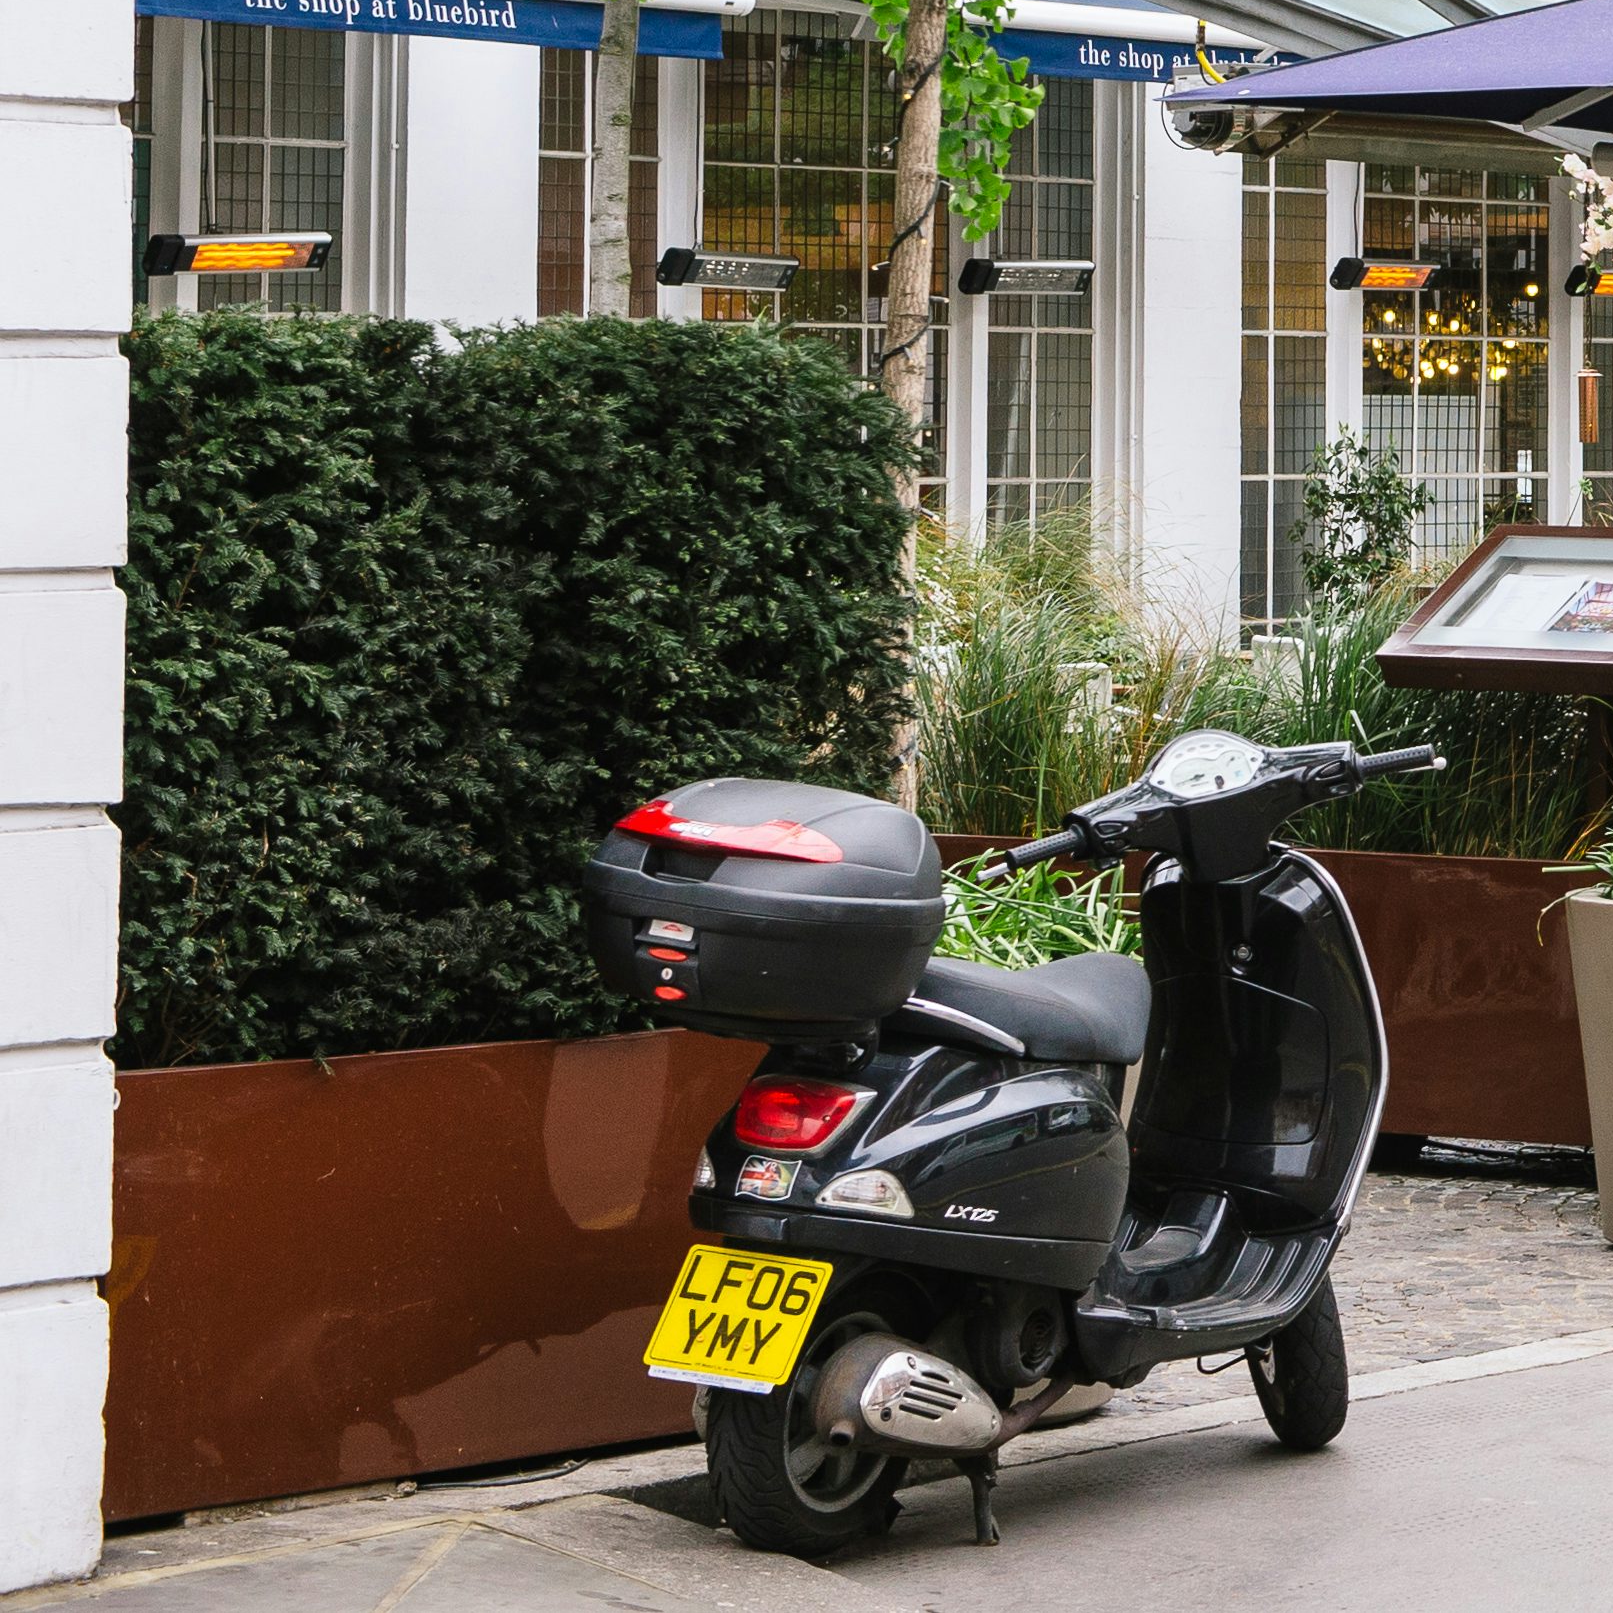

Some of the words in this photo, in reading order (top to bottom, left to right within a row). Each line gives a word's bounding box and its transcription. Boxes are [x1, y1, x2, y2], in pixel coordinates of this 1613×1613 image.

[1079, 39, 1111, 66] the
[1119, 43, 1164, 77] shop
[679, 1254, 819, 1316] LF06
[682, 1309, 783, 1365] YMY
